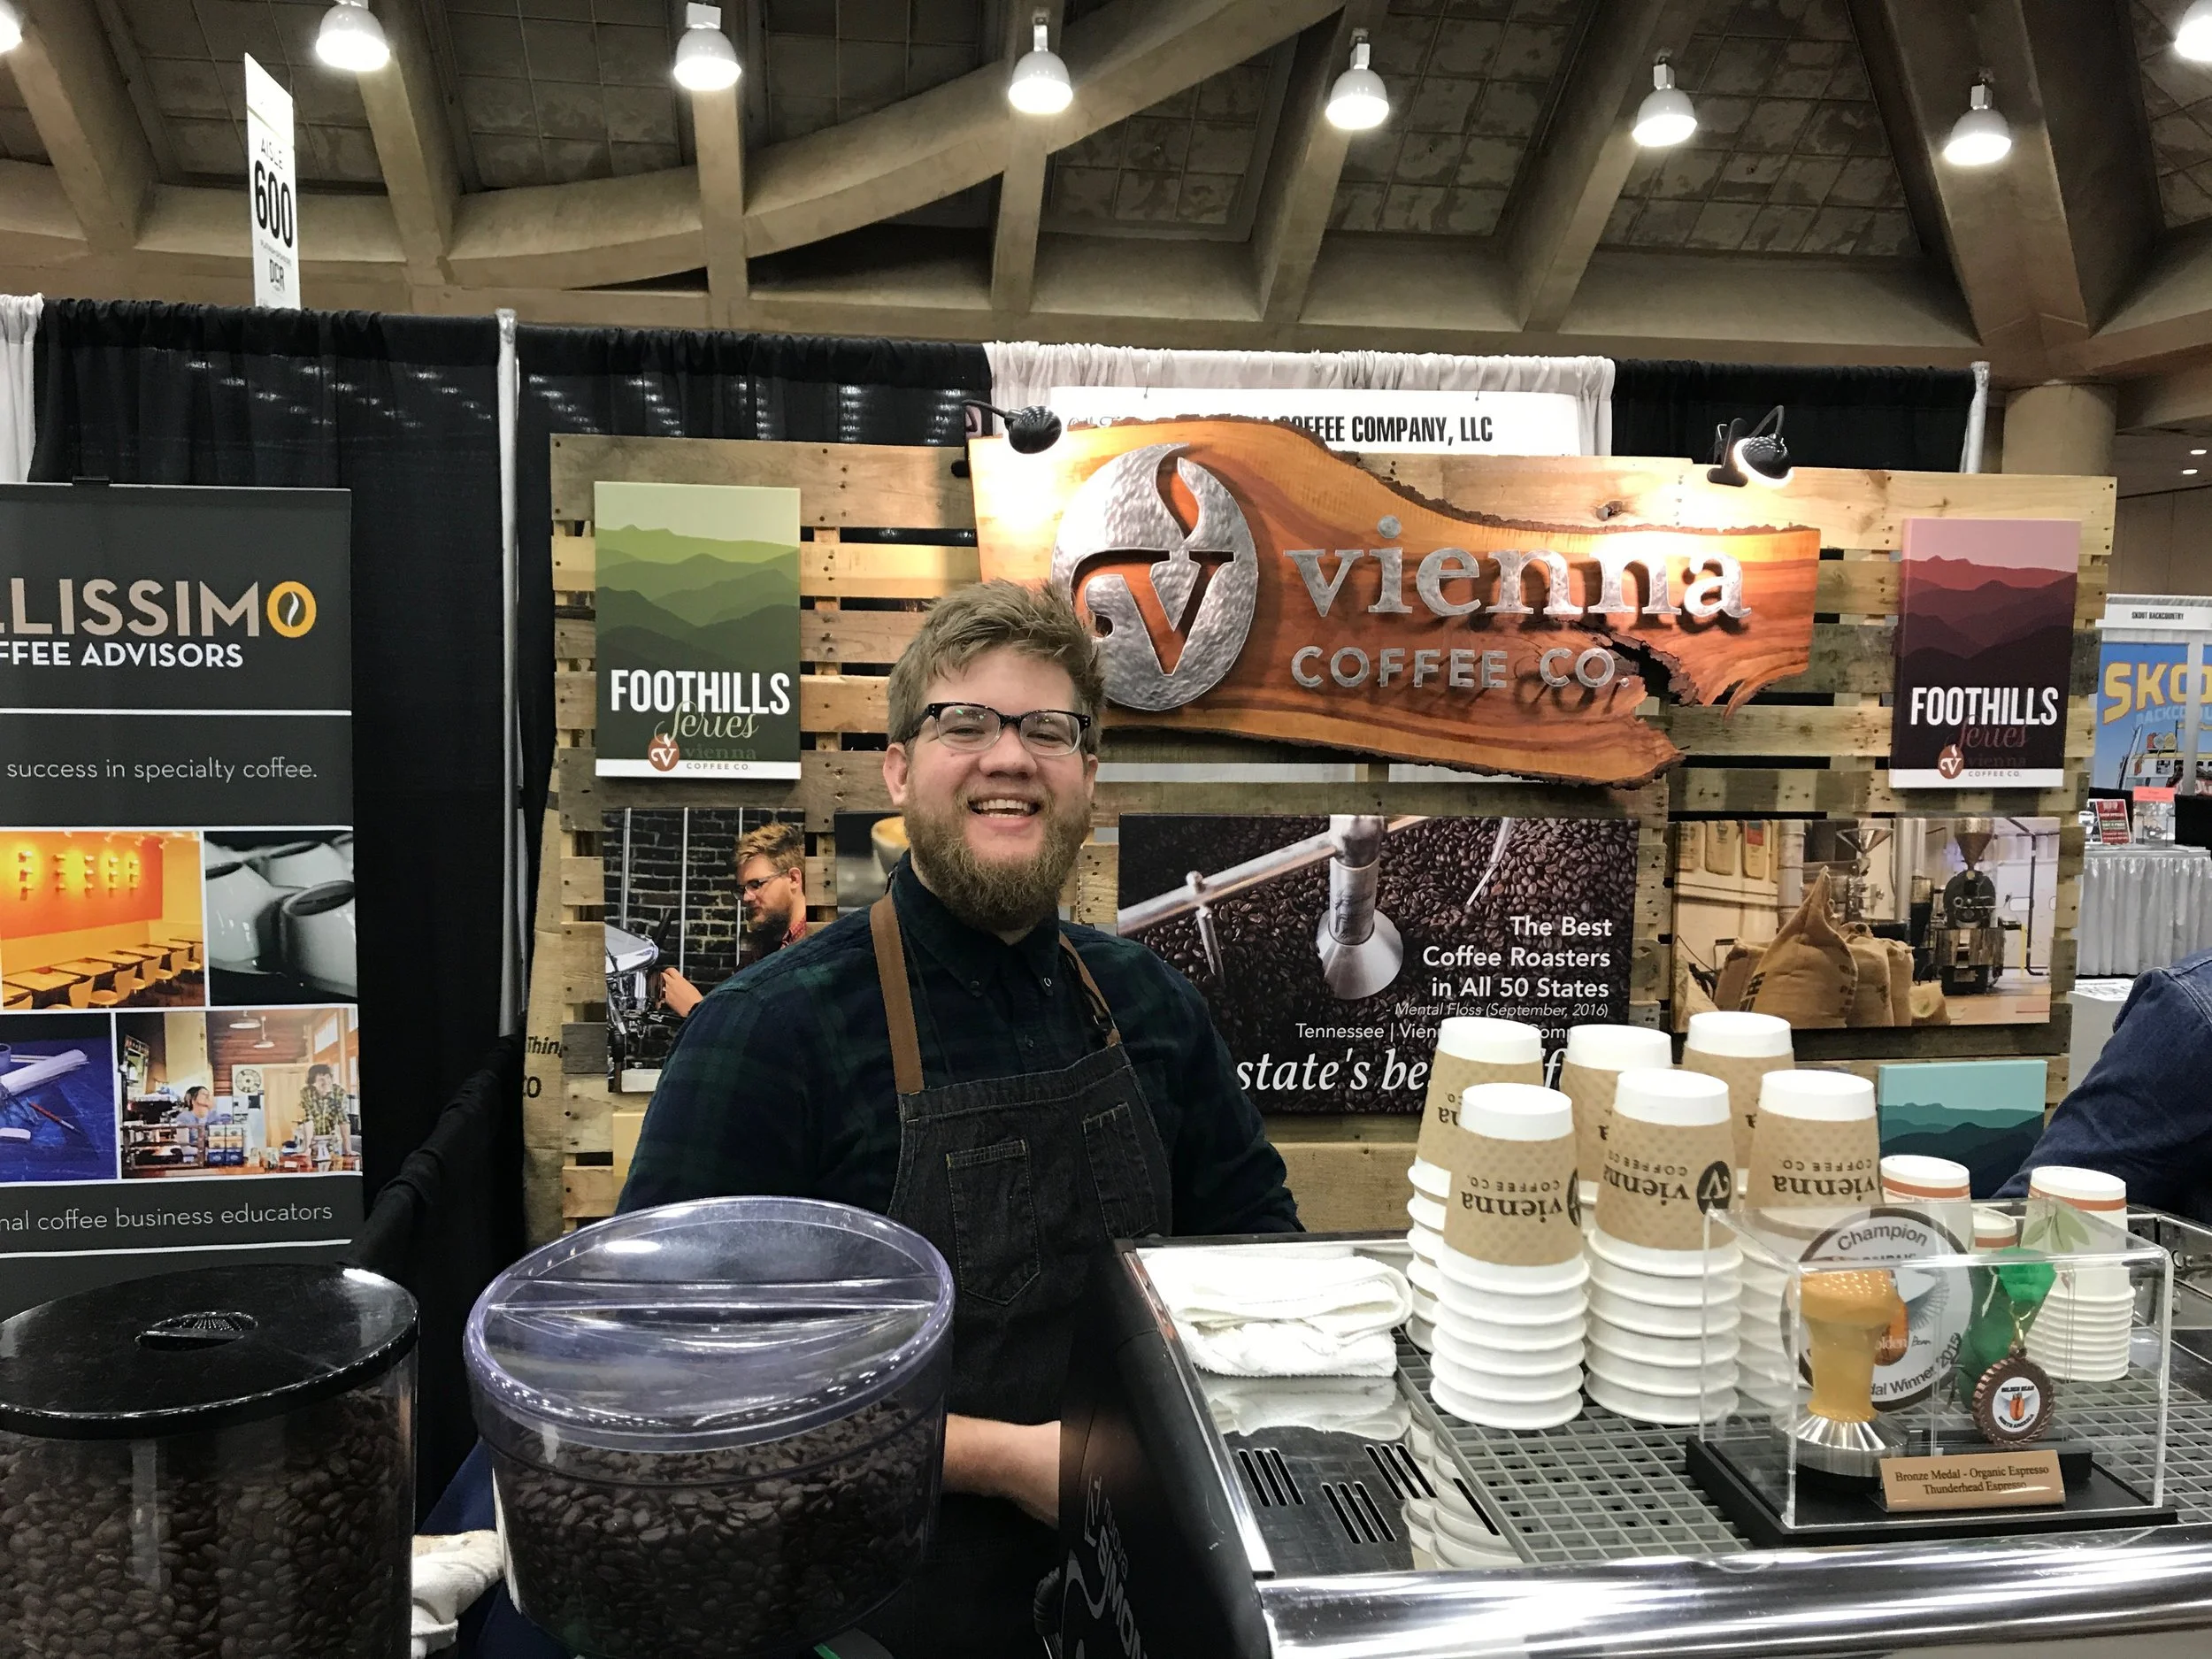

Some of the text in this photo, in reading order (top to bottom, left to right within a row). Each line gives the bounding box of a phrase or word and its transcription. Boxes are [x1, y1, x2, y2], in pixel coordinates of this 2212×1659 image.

[255, 159, 293, 248] 600
[270, 258, 285, 292] DCR
[1279, 415, 1493, 447] FFEE COMPANY, LLC
[1283, 515, 1752, 618] vienna
[0, 578, 317, 638] LISSIMO
[81, 642, 243, 668] ADVISORS
[1291, 645, 1630, 688] COFFEE CO.
[611, 669, 791, 715] FOOTHILLS
[1910, 686, 2059, 726] FOOTHILLS
[654, 700, 759, 745] Series
[1950, 714, 2028, 749] Series
[685, 742, 757, 760] vienna
[1968, 753, 2026, 768] vienna
[6, 757, 318, 783] success in specialty coffee.
[686, 762, 730, 771] COFFEE
[1509, 915, 1613, 936] The Best
[1423, 945, 1611, 967] Coffee Roasters
[1432, 976, 1609, 997] in All 50 States
[1394, 1002, 1442, 1016] Mental
[1447, 1002, 1482, 1016] Floss
[1486, 1002, 1568, 1018] (September,
[1572, 1002, 1609, 1018] 2016)
[1295, 1023, 1384, 1039] Tennessee
[1400, 1023, 1440, 1039] Vien
[528, 1036, 562, 1058] Thin
[1237, 1048, 1431, 1090] state's be
[1624, 1156, 1688, 1177] COFFEE
[1812, 1159, 1872, 1171] COFFEE
[1497, 1179, 1560, 1193] COFFEE
[1772, 1174, 1877, 1202] vienna
[37, 1209, 108, 1231] coffee
[115, 1206, 214, 1228] business
[221, 1202, 334, 1225] educators
[1461, 1191, 1563, 1223] vienna
[1838, 1224, 1928, 1251] Champion
[1875, 1334, 1908, 1350] olden
[1890, 1365, 1935, 1394] Winner
[1895, 1471, 1929, 1482] Bronze
[1932, 1469, 1960, 1480] Medal
[1970, 1466, 2006, 1479] Organic
[2008, 1465, 2049, 1479] Espresso
[1923, 1480, 2027, 1494] Thunderhead Espresso
